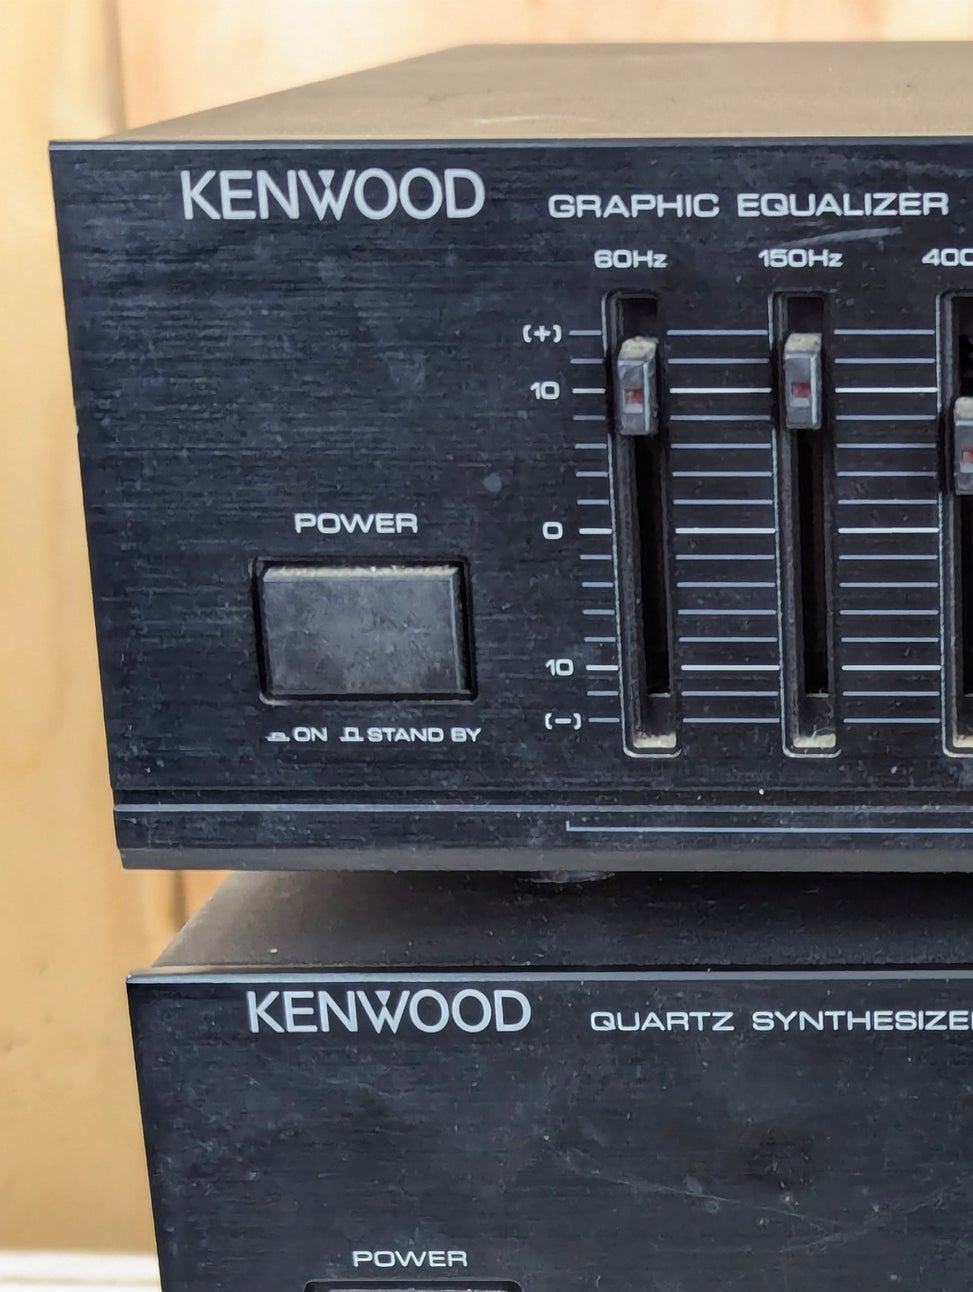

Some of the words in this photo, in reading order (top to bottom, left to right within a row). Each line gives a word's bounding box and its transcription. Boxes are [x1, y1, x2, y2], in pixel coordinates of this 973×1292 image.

[180, 167, 485, 221] KENWOOD
[548, 193, 720, 219] GRAPHIC
[736, 192, 949, 218] EQUALIZER
[594, 249, 668, 269] 60Hz
[758, 248, 843, 268] 150Hz
[522, 324, 562, 343] (+)
[530, 381, 560, 400] 10
[294, 512, 418, 534] POWER
[542, 521, 563, 540] 0
[545, 658, 574, 676] 10
[293, 726, 328, 742] ON
[366, 727, 444, 743] STAND
[450, 727, 482, 743] BY
[246, 988, 532, 1034] KENWOOD
[590, 1011, 735, 1032] QUARTZ
[352, 1250, 468, 1268] POWER
